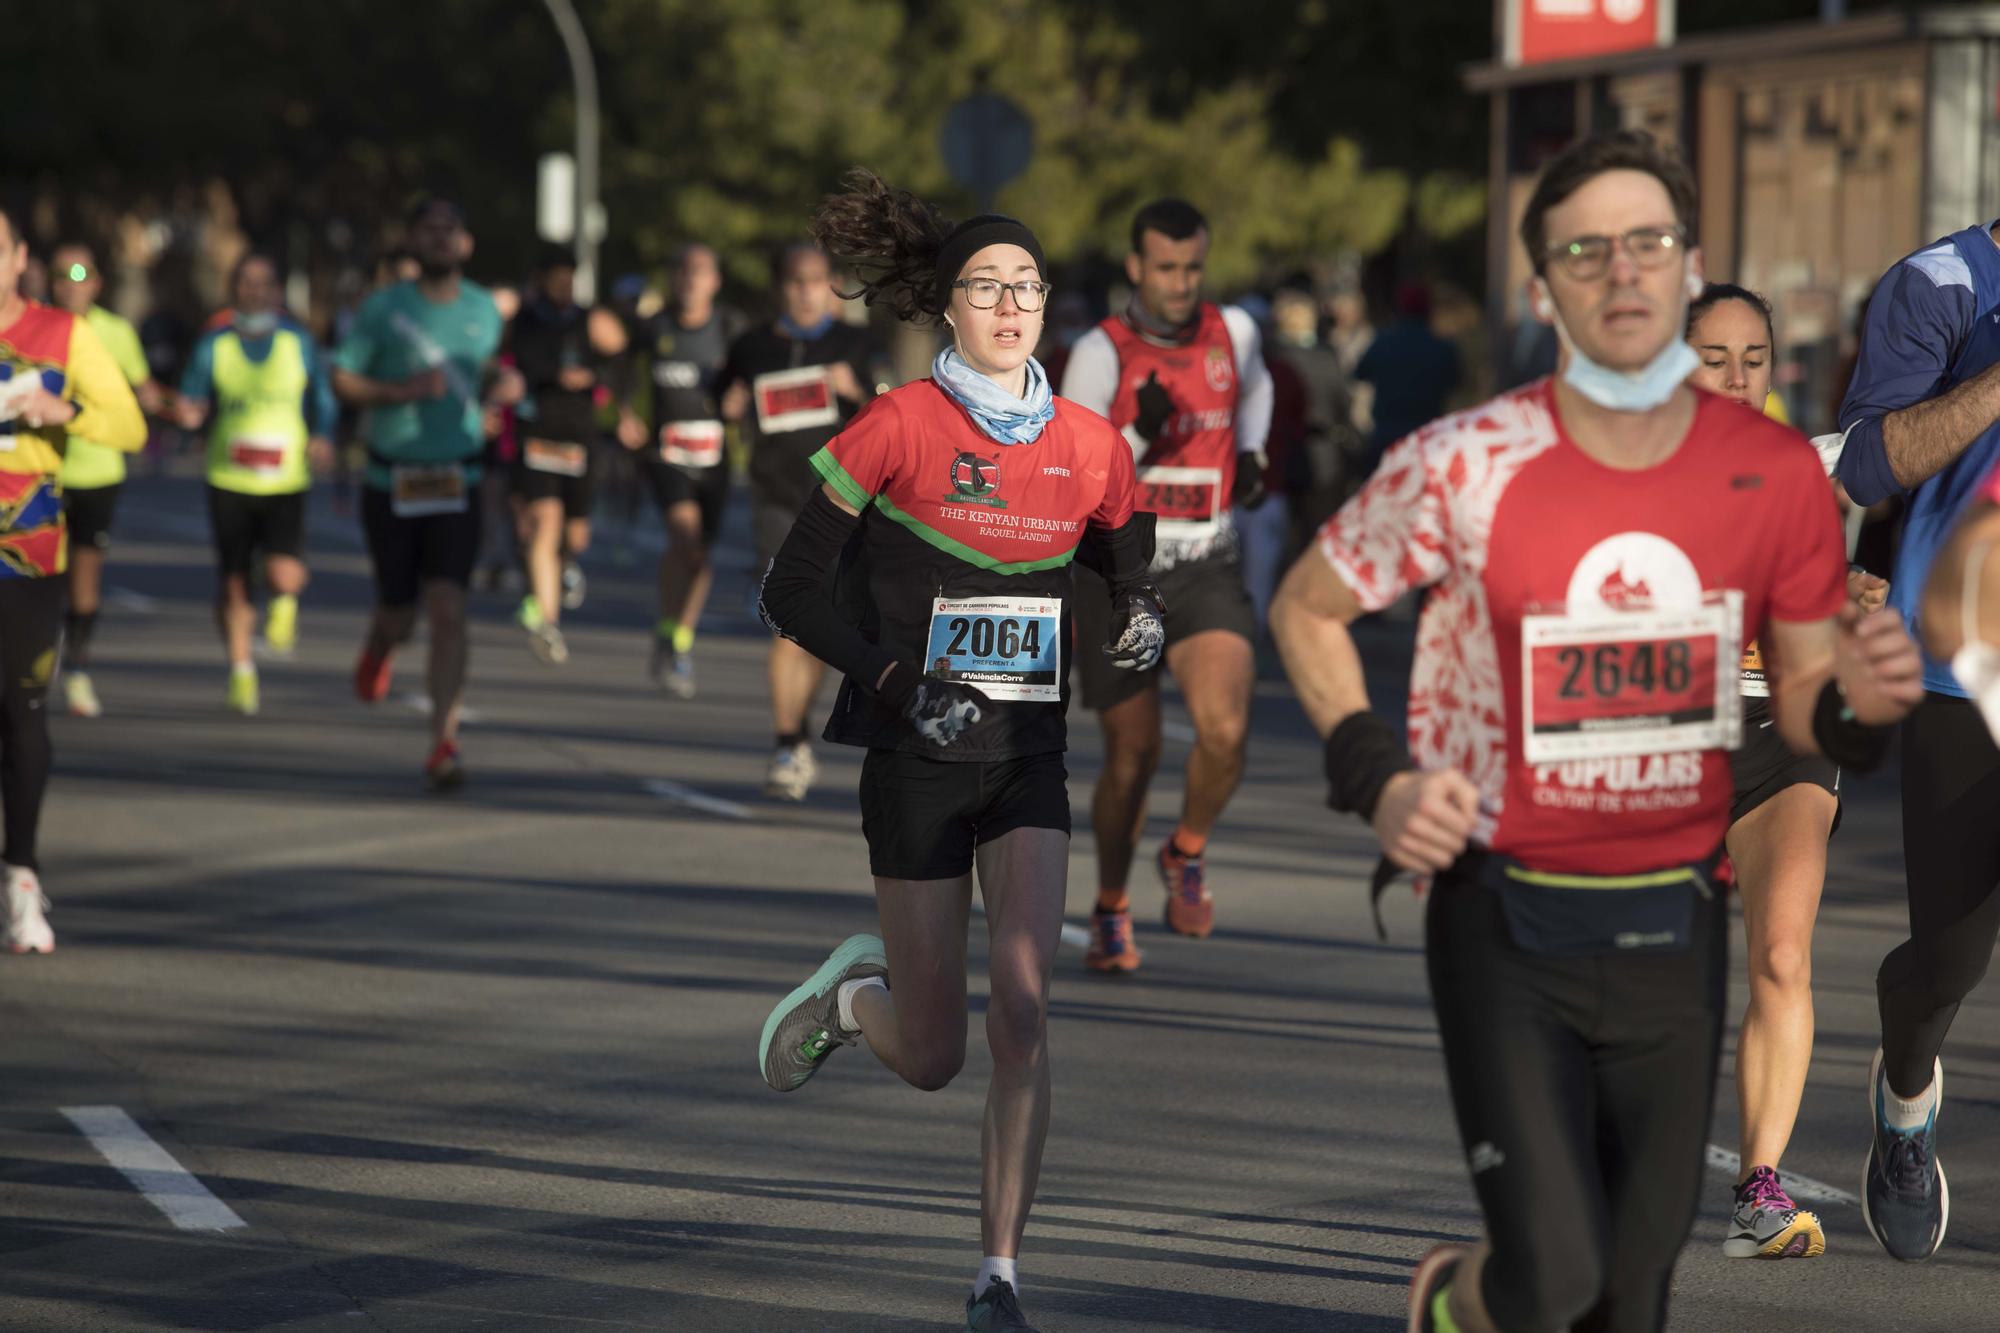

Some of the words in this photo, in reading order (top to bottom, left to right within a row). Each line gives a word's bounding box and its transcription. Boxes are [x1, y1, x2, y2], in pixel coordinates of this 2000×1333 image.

[1043, 467, 1071, 477] FASTER
[940, 506, 966, 521] THE
[969, 512, 1019, 527] KENYAN
[1022, 517, 1061, 531] URBAN
[979, 526, 1016, 539] RAQUEL
[1018, 531, 1052, 543] LANDIN
[946, 617, 1040, 659] 2064
[972, 659, 1009, 667] PREFERENT
[1557, 640, 1692, 699] 2648
[961, 672, 1024, 682] #ValènciaCorre
